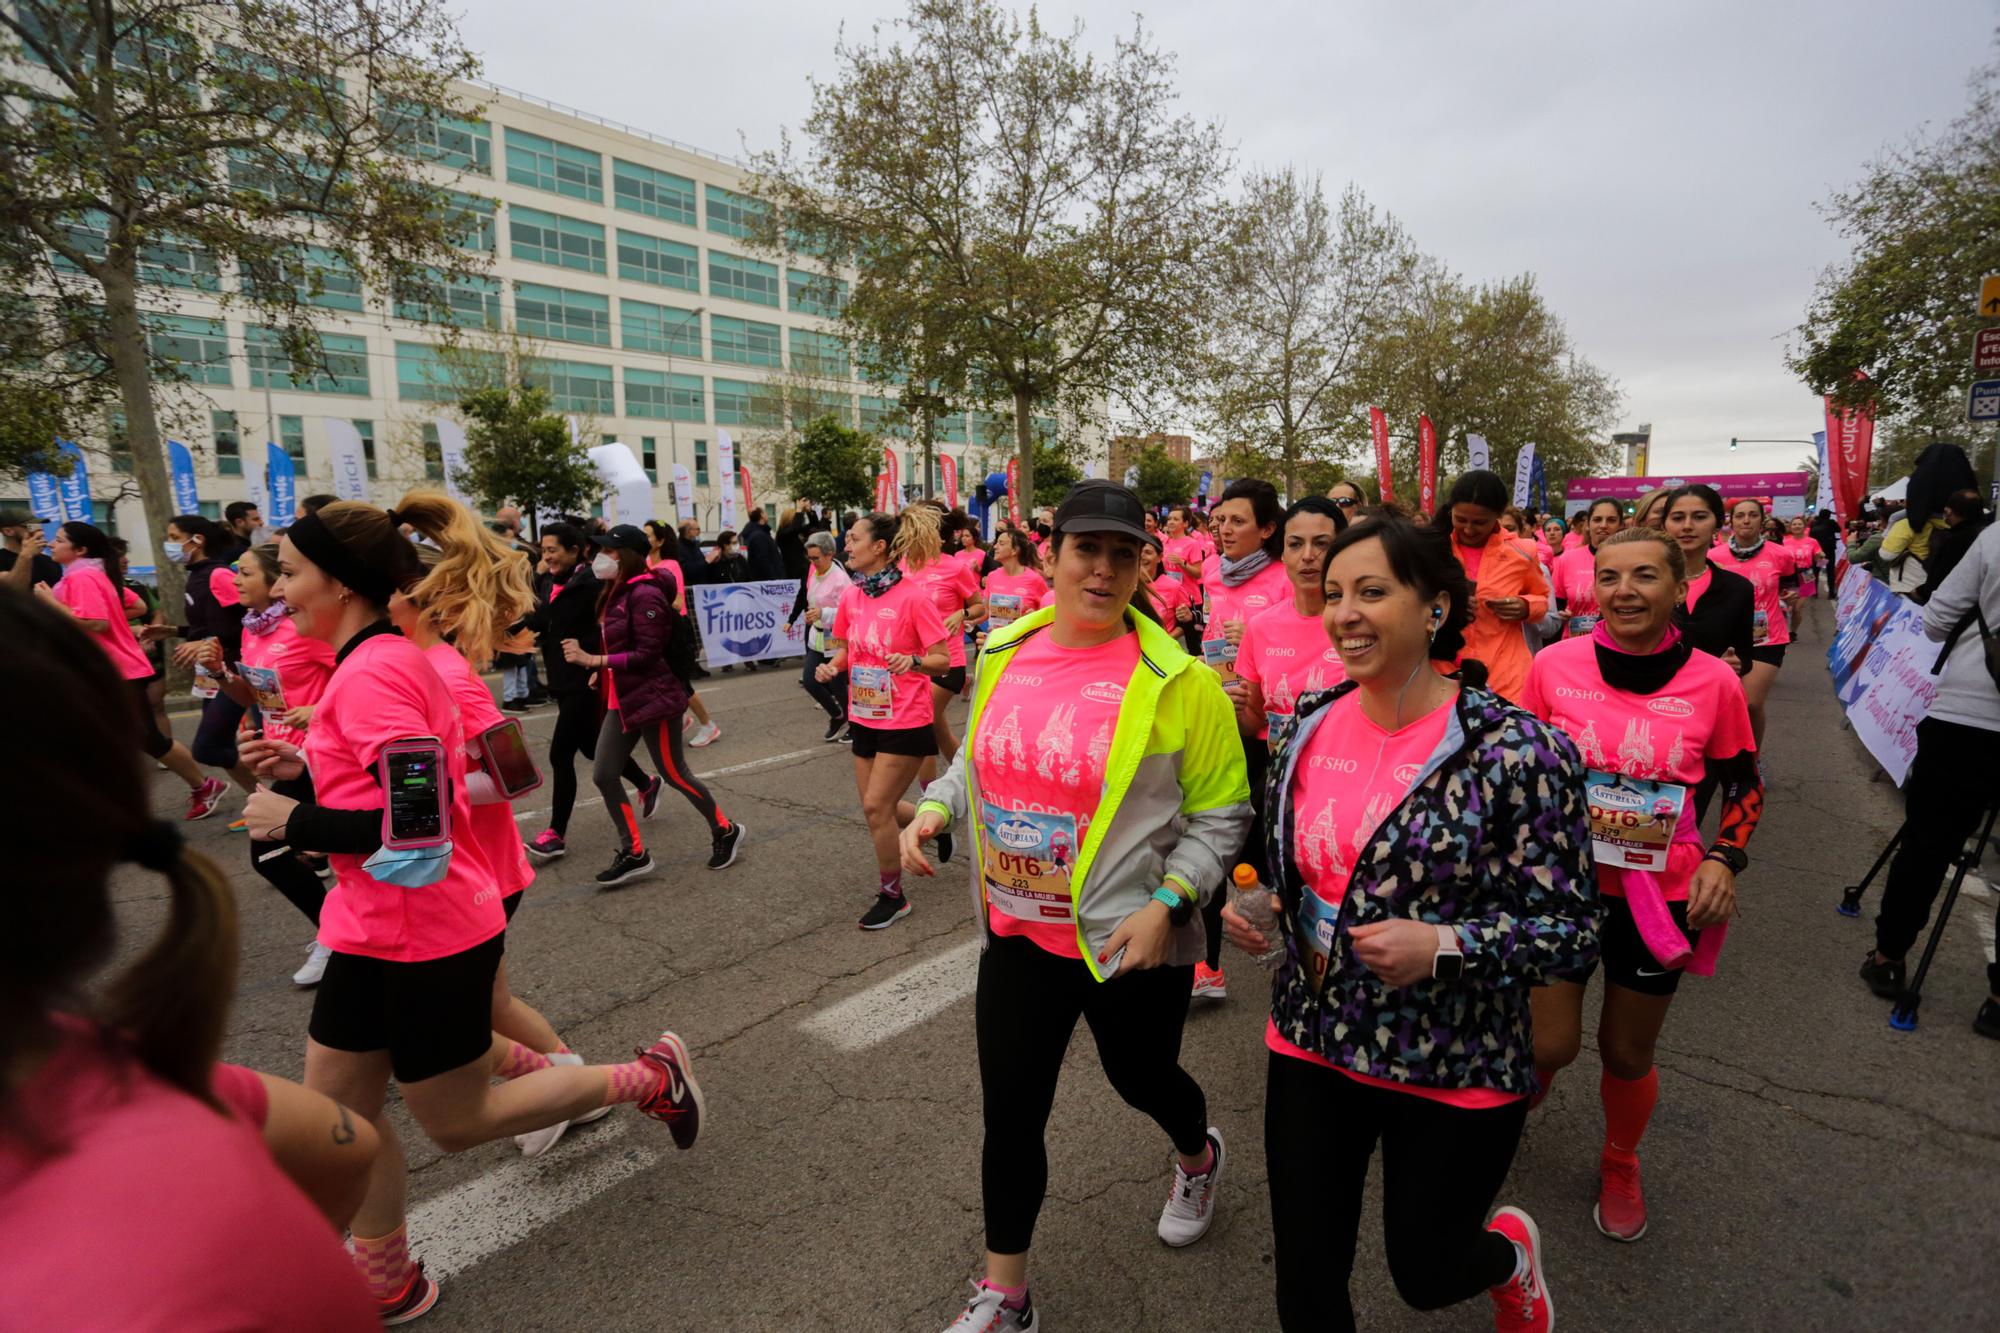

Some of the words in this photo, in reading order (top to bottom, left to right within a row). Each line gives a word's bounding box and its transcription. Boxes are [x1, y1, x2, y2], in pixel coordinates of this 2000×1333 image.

[702, 602, 775, 635] Fitness
[1556, 687, 1605, 701] OYSHO
[1309, 755, 1358, 773] OYSHO
[1593, 787, 1641, 805] ASTURIANA
[1590, 805, 1638, 827] 016
[1601, 826, 1620, 837] 379
[999, 852, 1040, 876] 016
[1011, 877, 1029, 889] 223
[1034, 892, 1056, 900] MUJER
